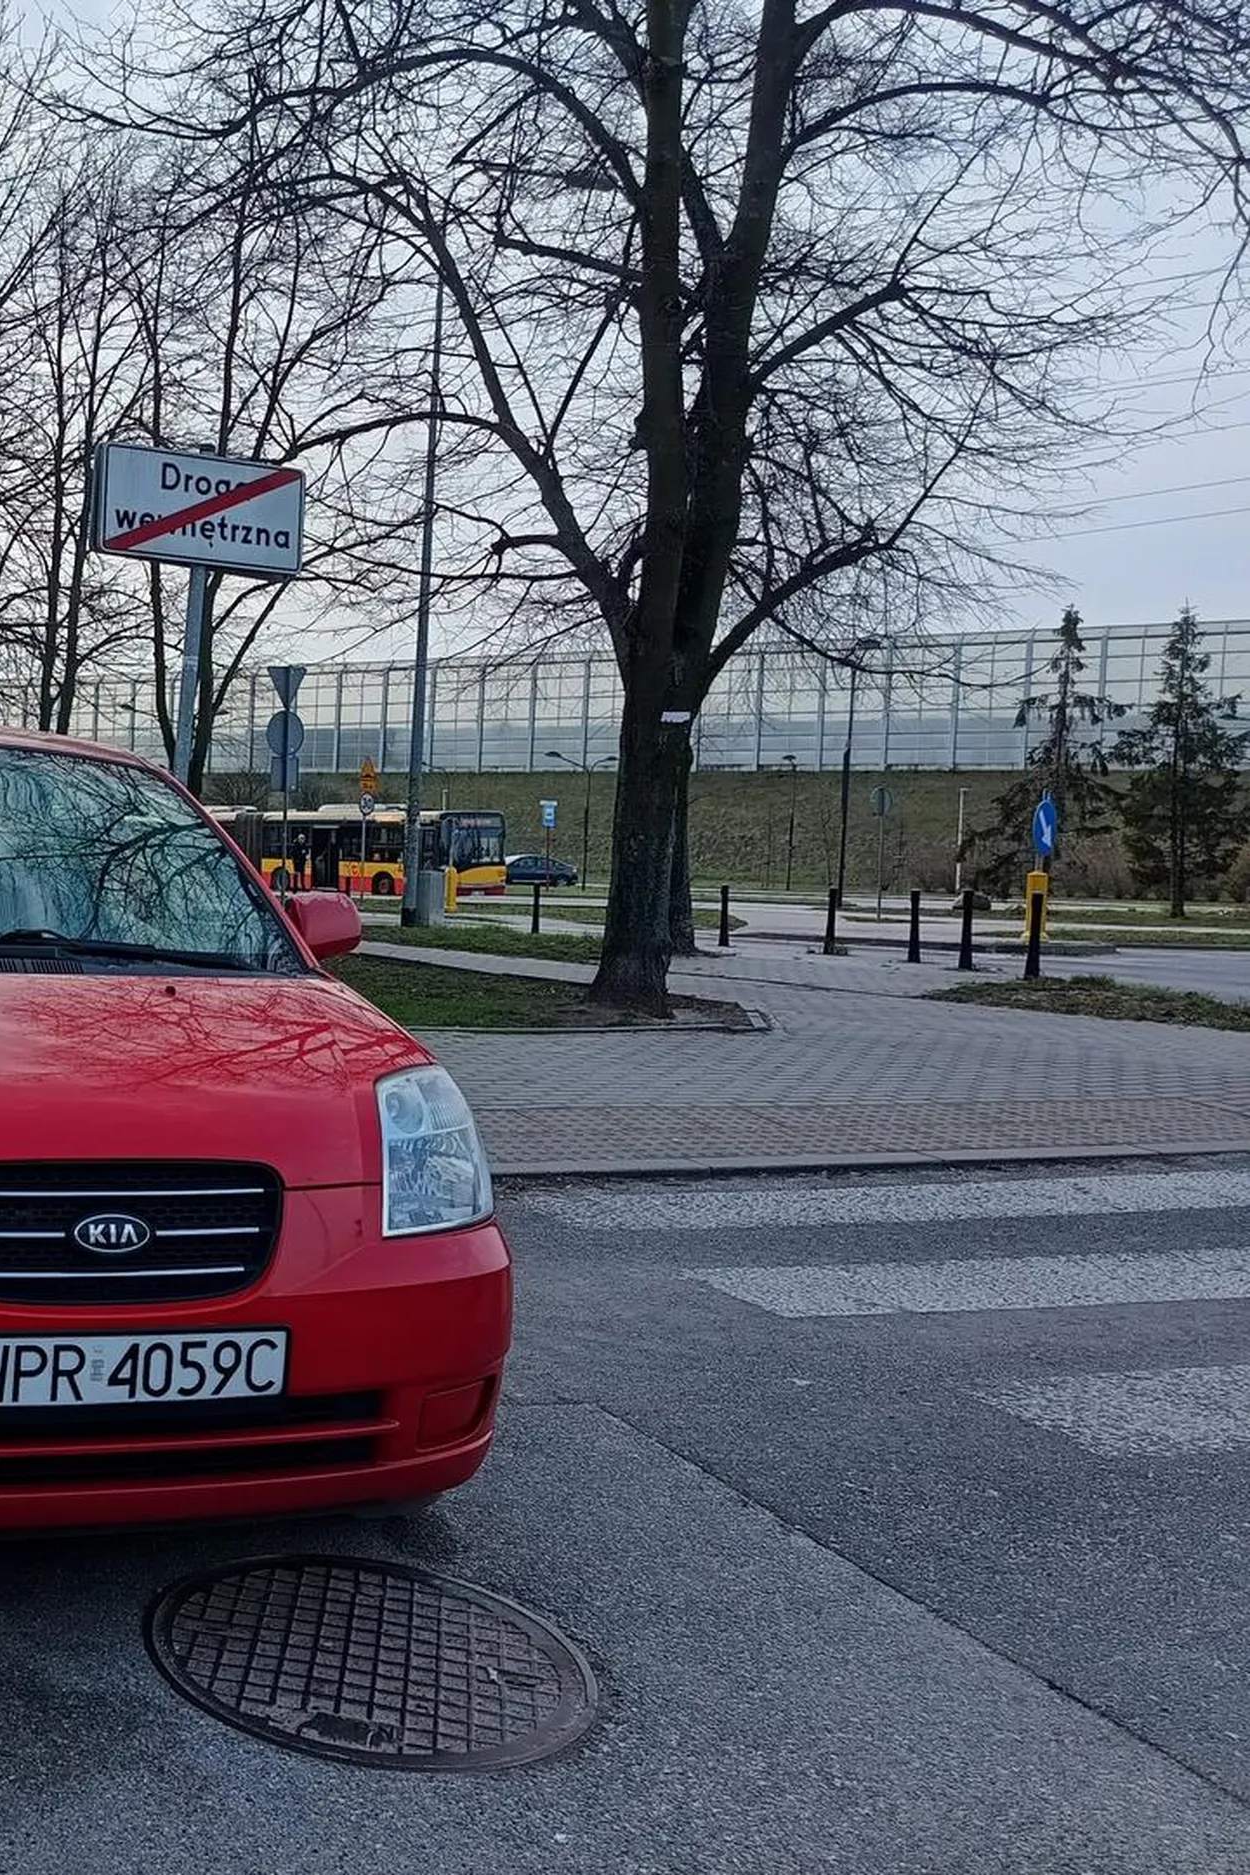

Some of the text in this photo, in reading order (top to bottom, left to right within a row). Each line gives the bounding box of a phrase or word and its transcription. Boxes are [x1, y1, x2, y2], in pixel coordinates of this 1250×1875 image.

[161, 462, 253, 501] Drog
[115, 508, 290, 549] wenętrzna
[88, 1224, 138, 1244] KIA
[107, 1338, 278, 1399] 4059C
